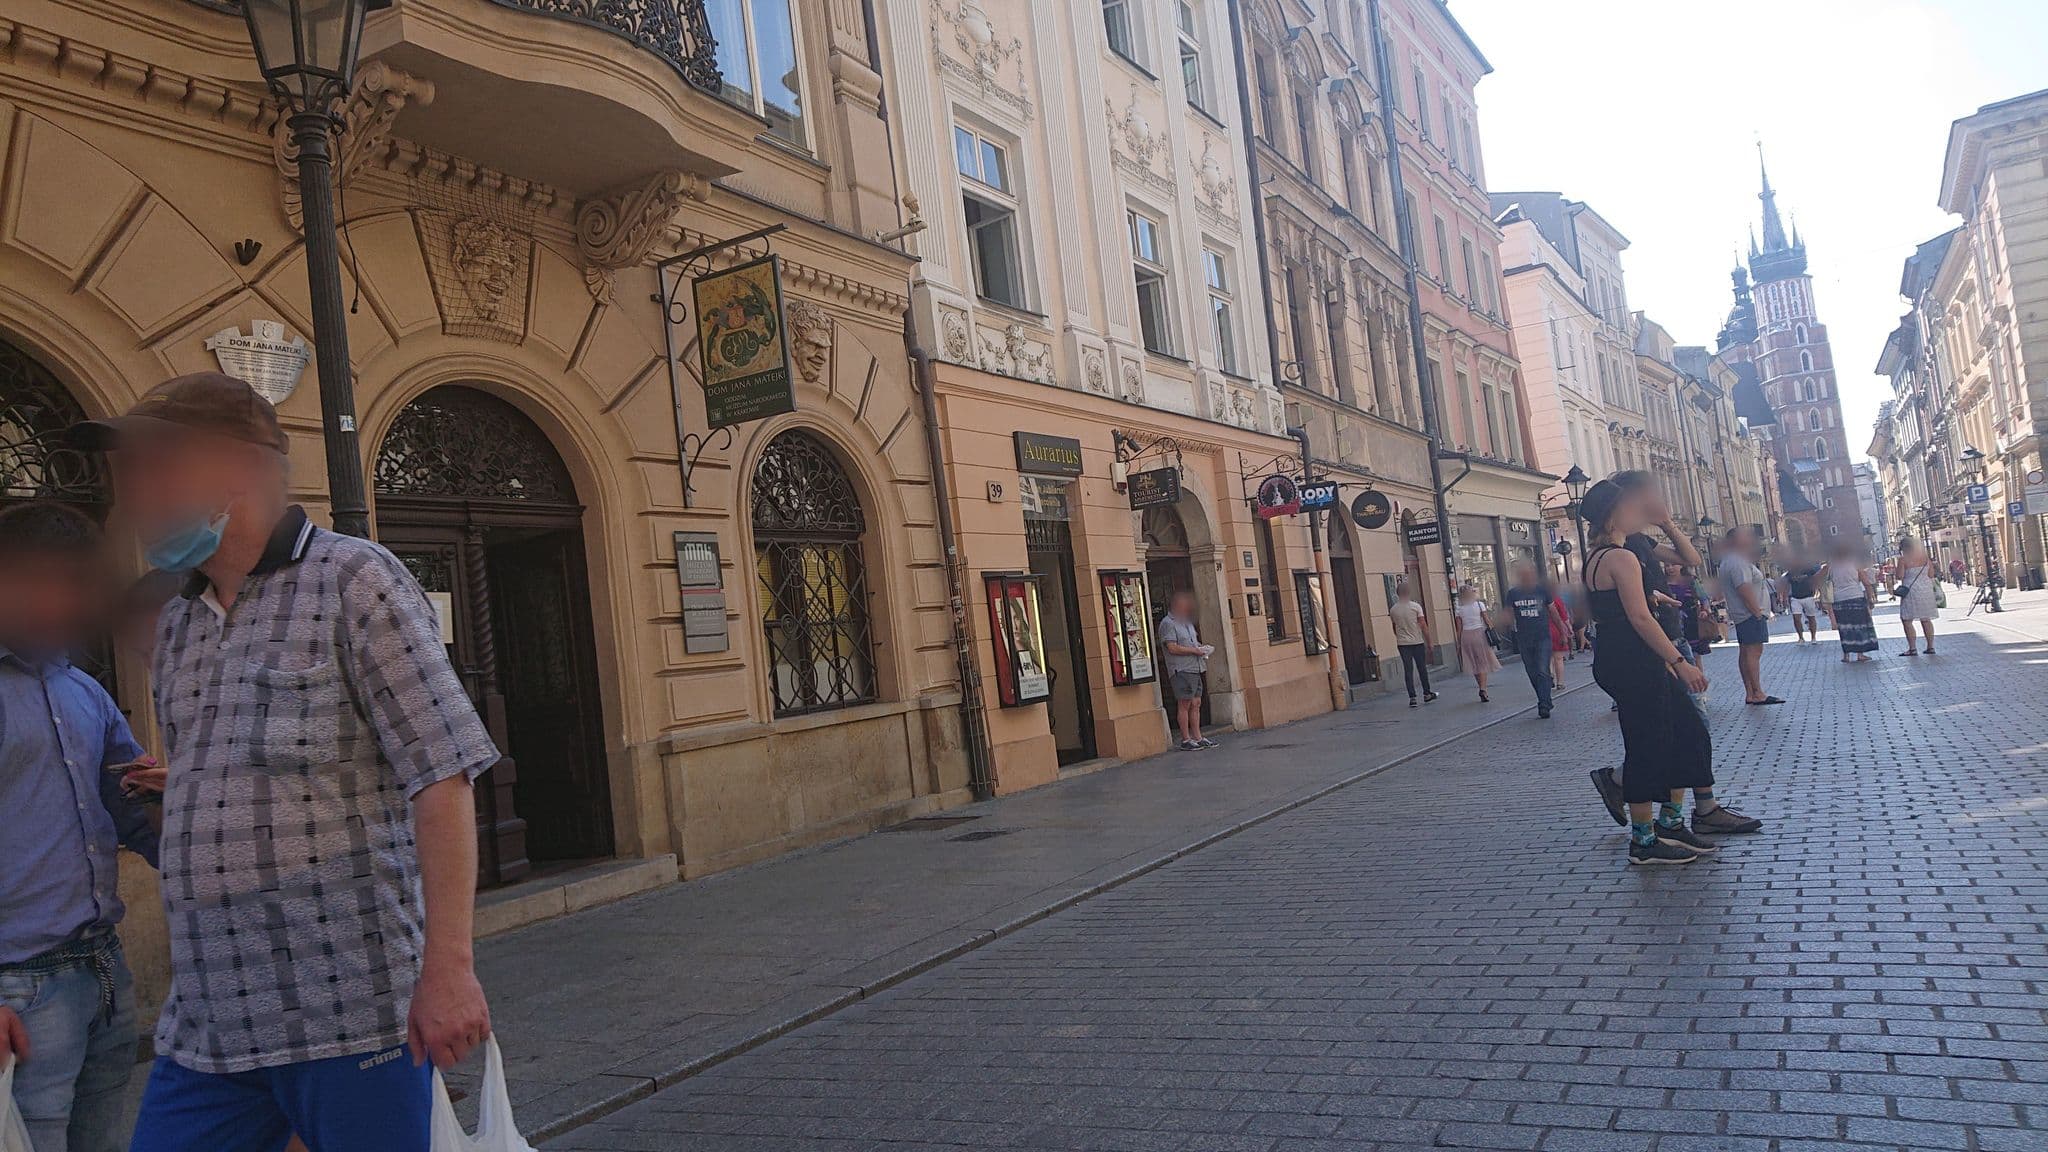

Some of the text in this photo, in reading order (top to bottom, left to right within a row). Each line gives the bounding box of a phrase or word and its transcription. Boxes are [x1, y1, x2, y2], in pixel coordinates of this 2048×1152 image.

[229, 339, 302, 354] DOM JANA MATEJKI
[707, 370, 786, 398] DOM JANA MATEJKI
[1024, 439, 1079, 465] Aurarius
[990, 483, 1003, 498] 39
[1134, 488, 1161, 498] TOURIST
[1299, 485, 1335, 501] LODY
[1972, 486, 1984, 500] P
[2012, 504, 2021, 514] P
[1409, 526, 1437, 536] KANTOR
[1410, 534, 1438, 542] EXCHANGE
[359, 1048, 403, 1070] erima
